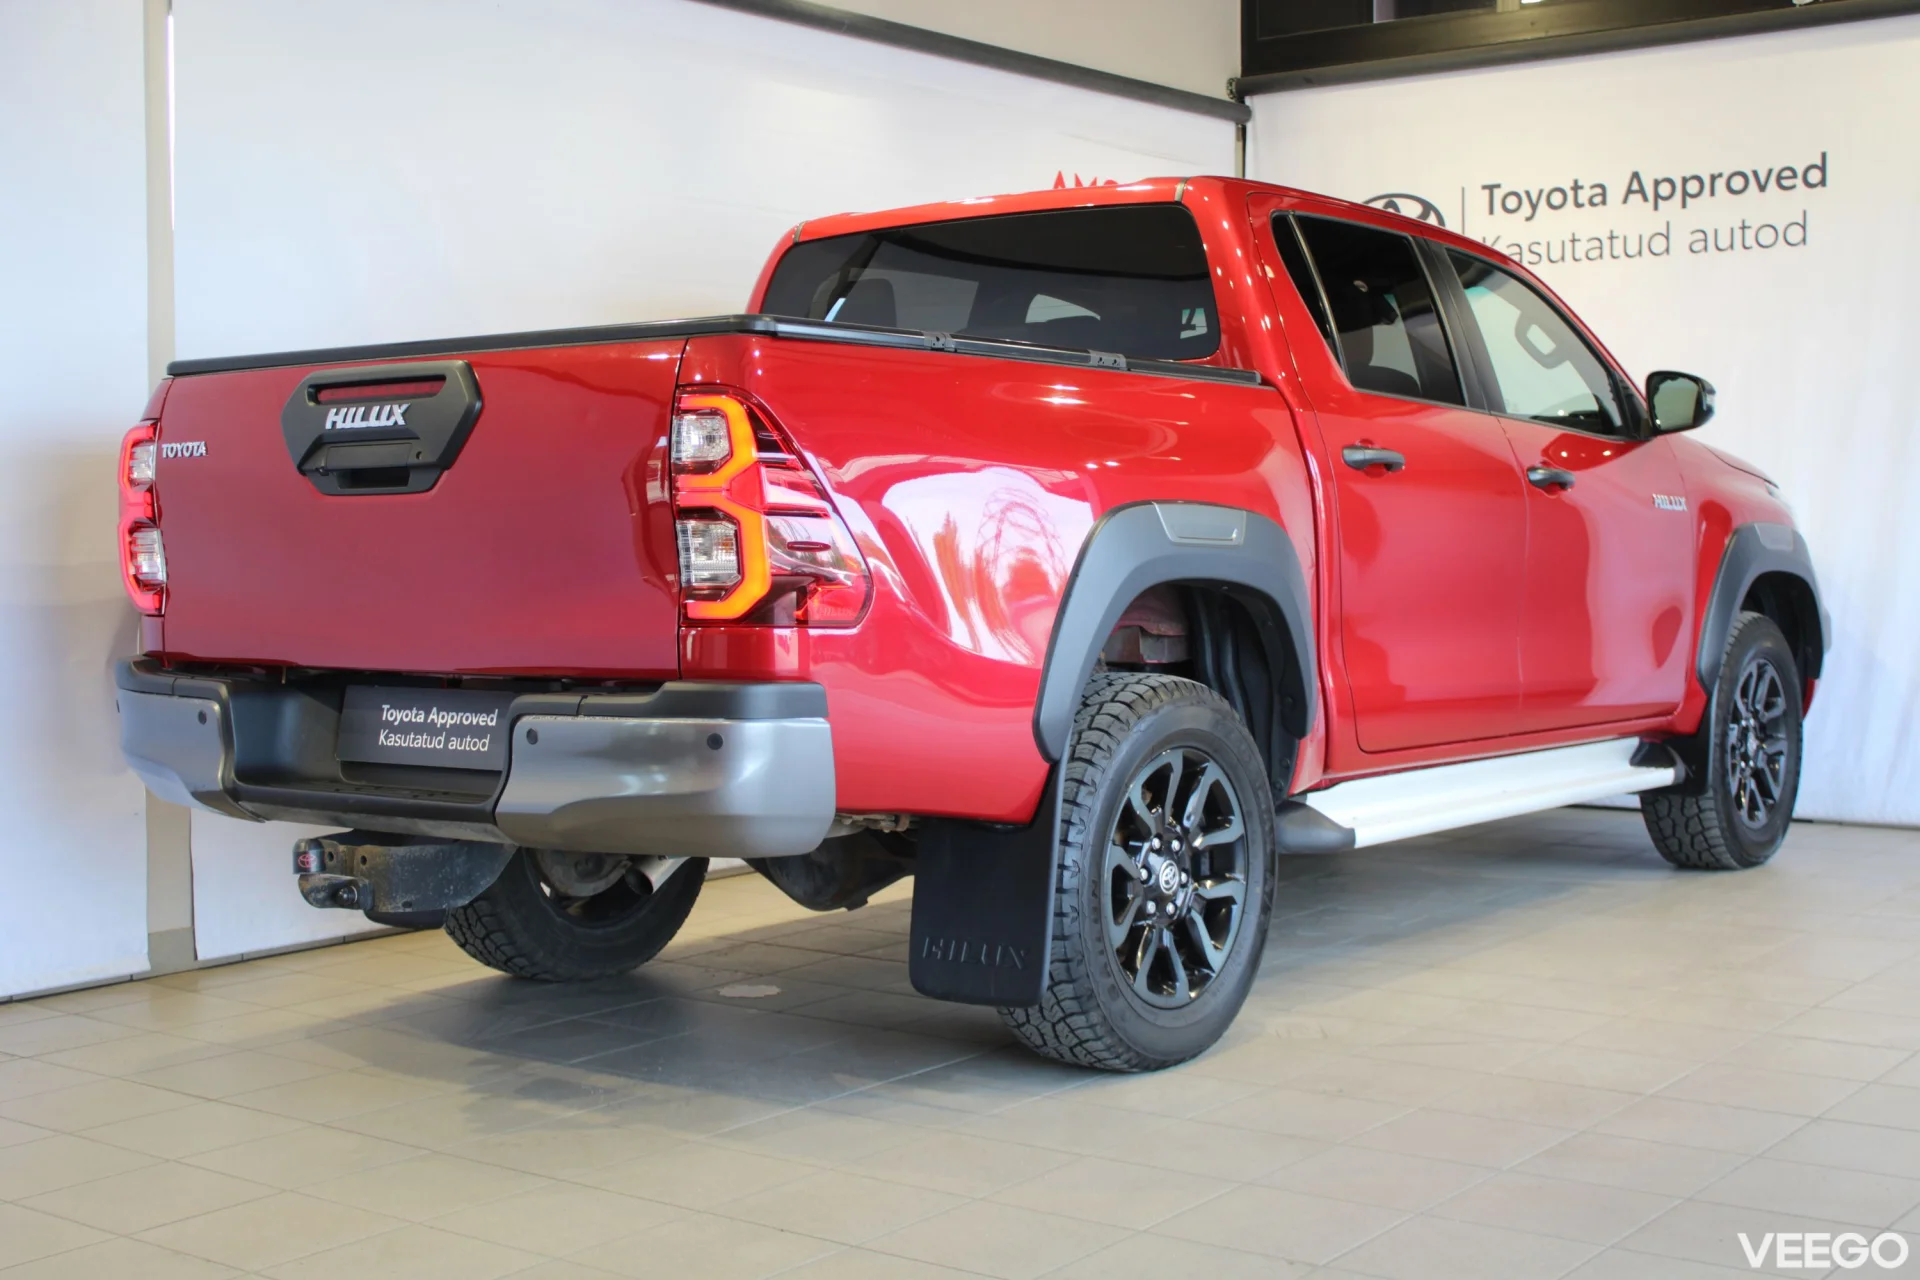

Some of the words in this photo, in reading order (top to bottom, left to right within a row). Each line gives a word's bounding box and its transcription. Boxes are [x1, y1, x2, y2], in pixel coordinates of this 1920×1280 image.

[1481, 178, 1608, 222] Toyota
[1622, 151, 1828, 212] Approved
[1688, 209, 1807, 254] autod
[325, 402, 411, 430] HILUX
[161, 441, 209, 459] TOYOTA
[1652, 493, 1688, 511] HILUX
[381, 704, 425, 726] Toyota
[427, 706, 498, 729] Approved
[378, 728, 446, 749] Kasutatud
[448, 733, 490, 752] autod
[922, 937, 1027, 970] HILUX
